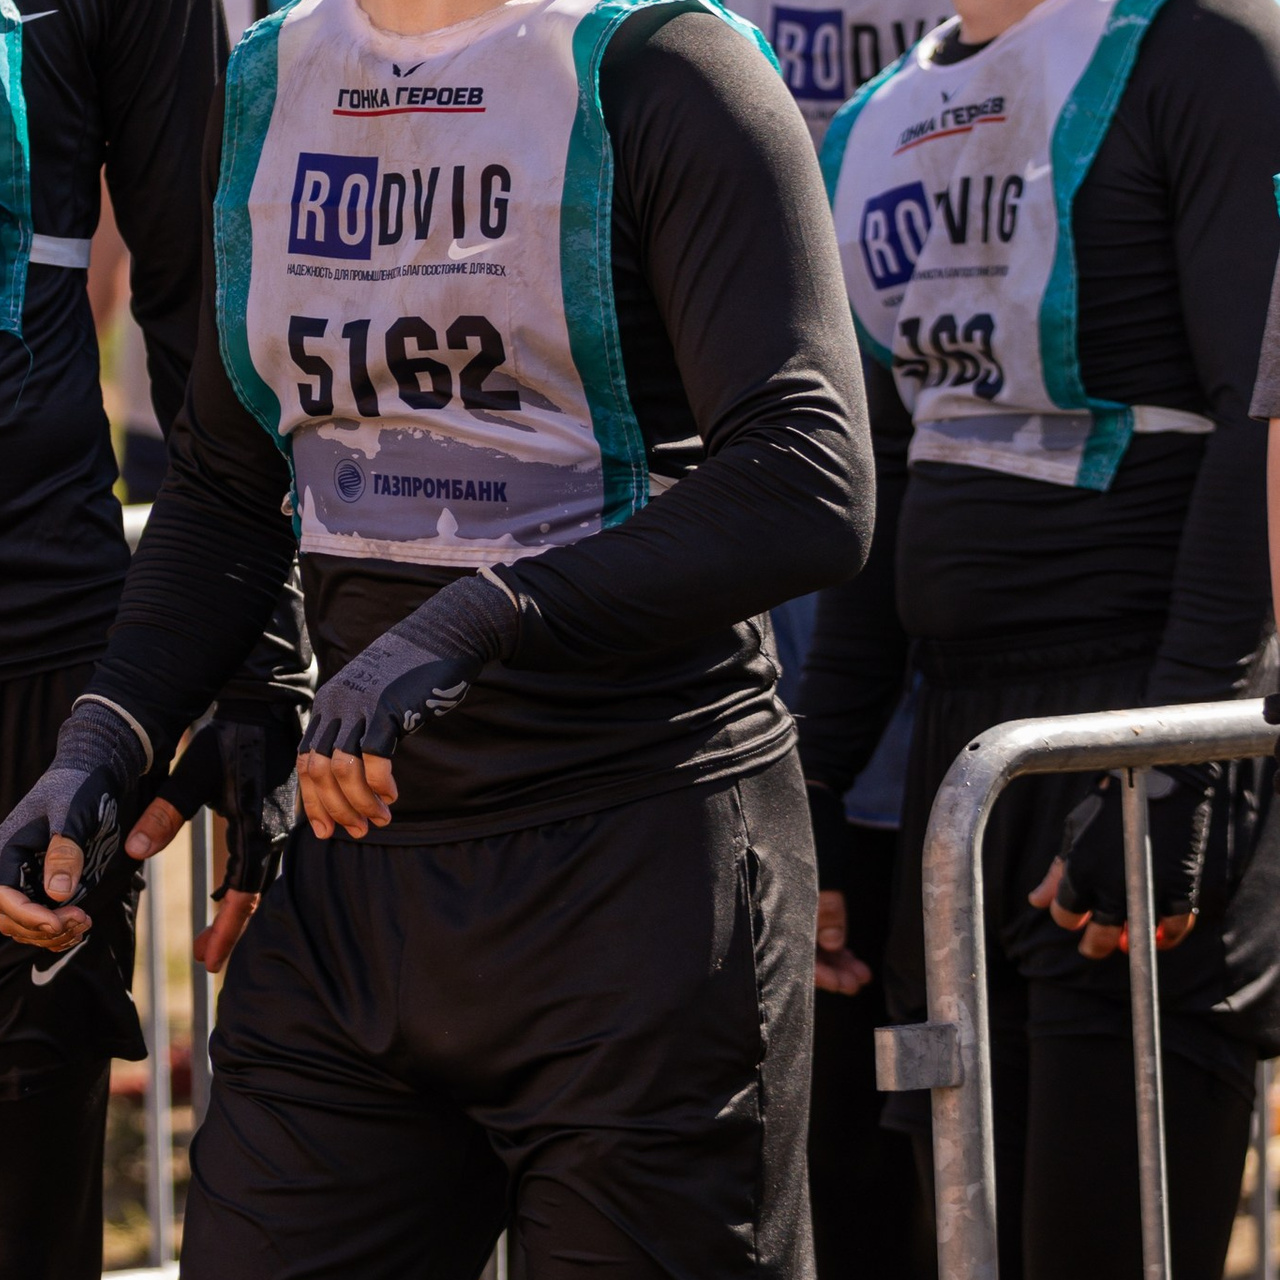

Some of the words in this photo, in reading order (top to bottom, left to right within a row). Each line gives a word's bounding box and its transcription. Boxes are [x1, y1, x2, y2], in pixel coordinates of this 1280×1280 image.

[337, 88, 390, 109] ГОНКА
[395, 86, 484, 106] ГЕРОЕВ
[296, 163, 512, 246] RODVIG
[286, 263, 333, 279] НАДЕЖНОСТЬ
[333, 269, 350, 281] ДЛЯ
[402, 262, 468, 277] БЛАГОСОСТОЯНИЕ
[469, 262, 486, 275] ДЛЯ
[486, 263, 506, 277] ВСЕХ
[287, 315, 521, 417] 5162
[373, 473, 508, 503] ГАЗПРОМБАНК
